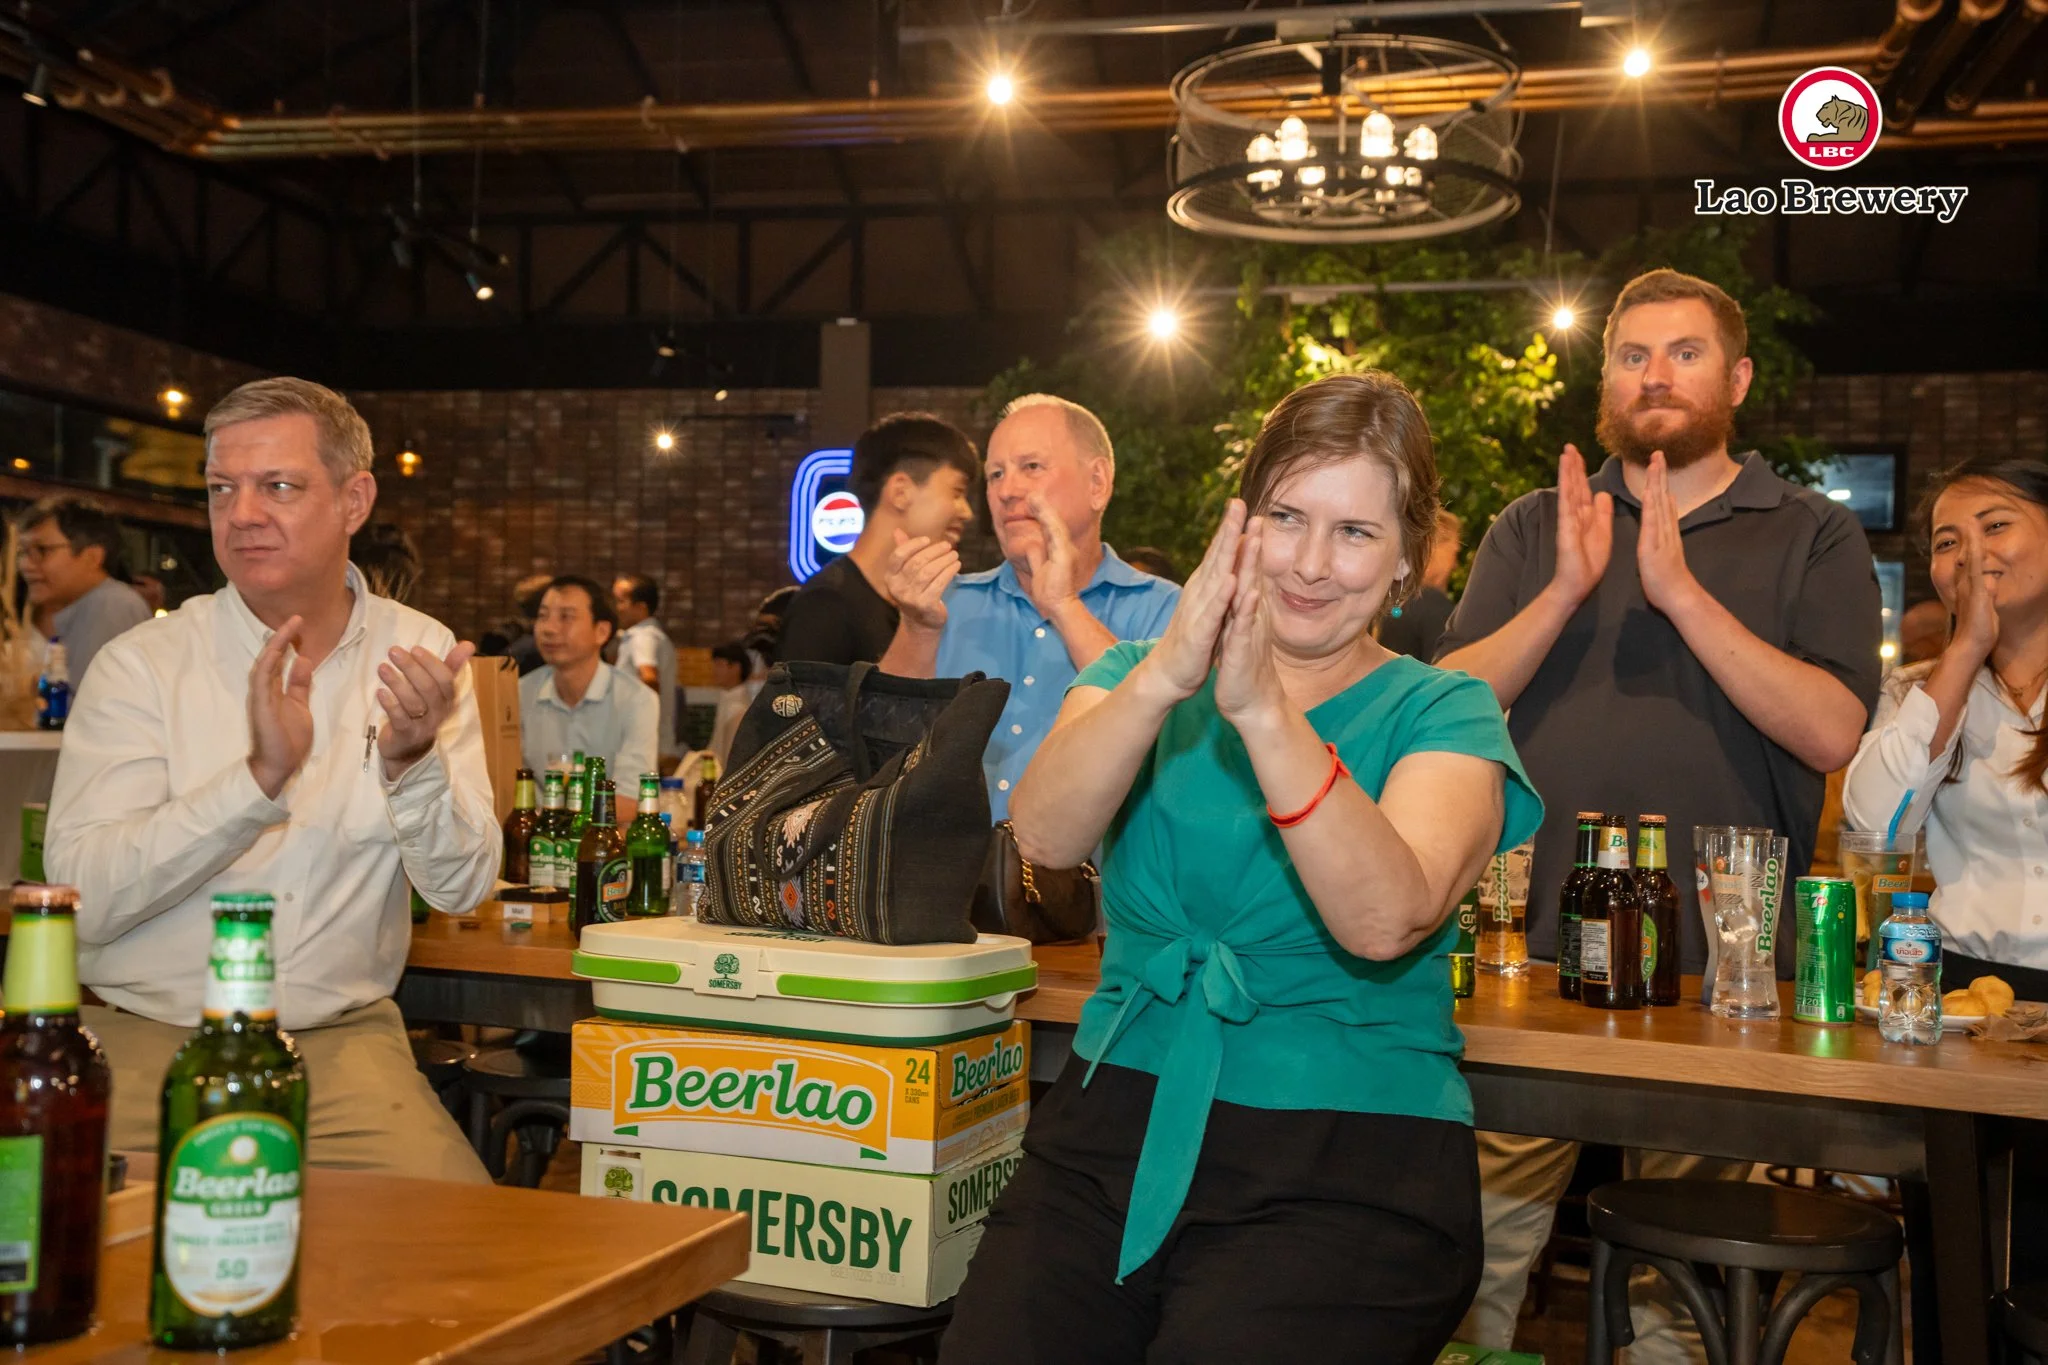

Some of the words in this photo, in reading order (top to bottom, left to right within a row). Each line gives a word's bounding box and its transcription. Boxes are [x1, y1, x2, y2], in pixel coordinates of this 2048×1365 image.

[1491, 853, 1512, 923] Beerla
[1755, 857, 1779, 954] Beerlao
[708, 979, 743, 990] SOMERSBY
[627, 1053, 875, 1128] Beerlao
[905, 1057, 930, 1085] 24
[951, 1038, 1023, 1099] Beerlao
[174, 1166, 299, 1198] Beerlao
[948, 1158, 1020, 1225] SOMERS
